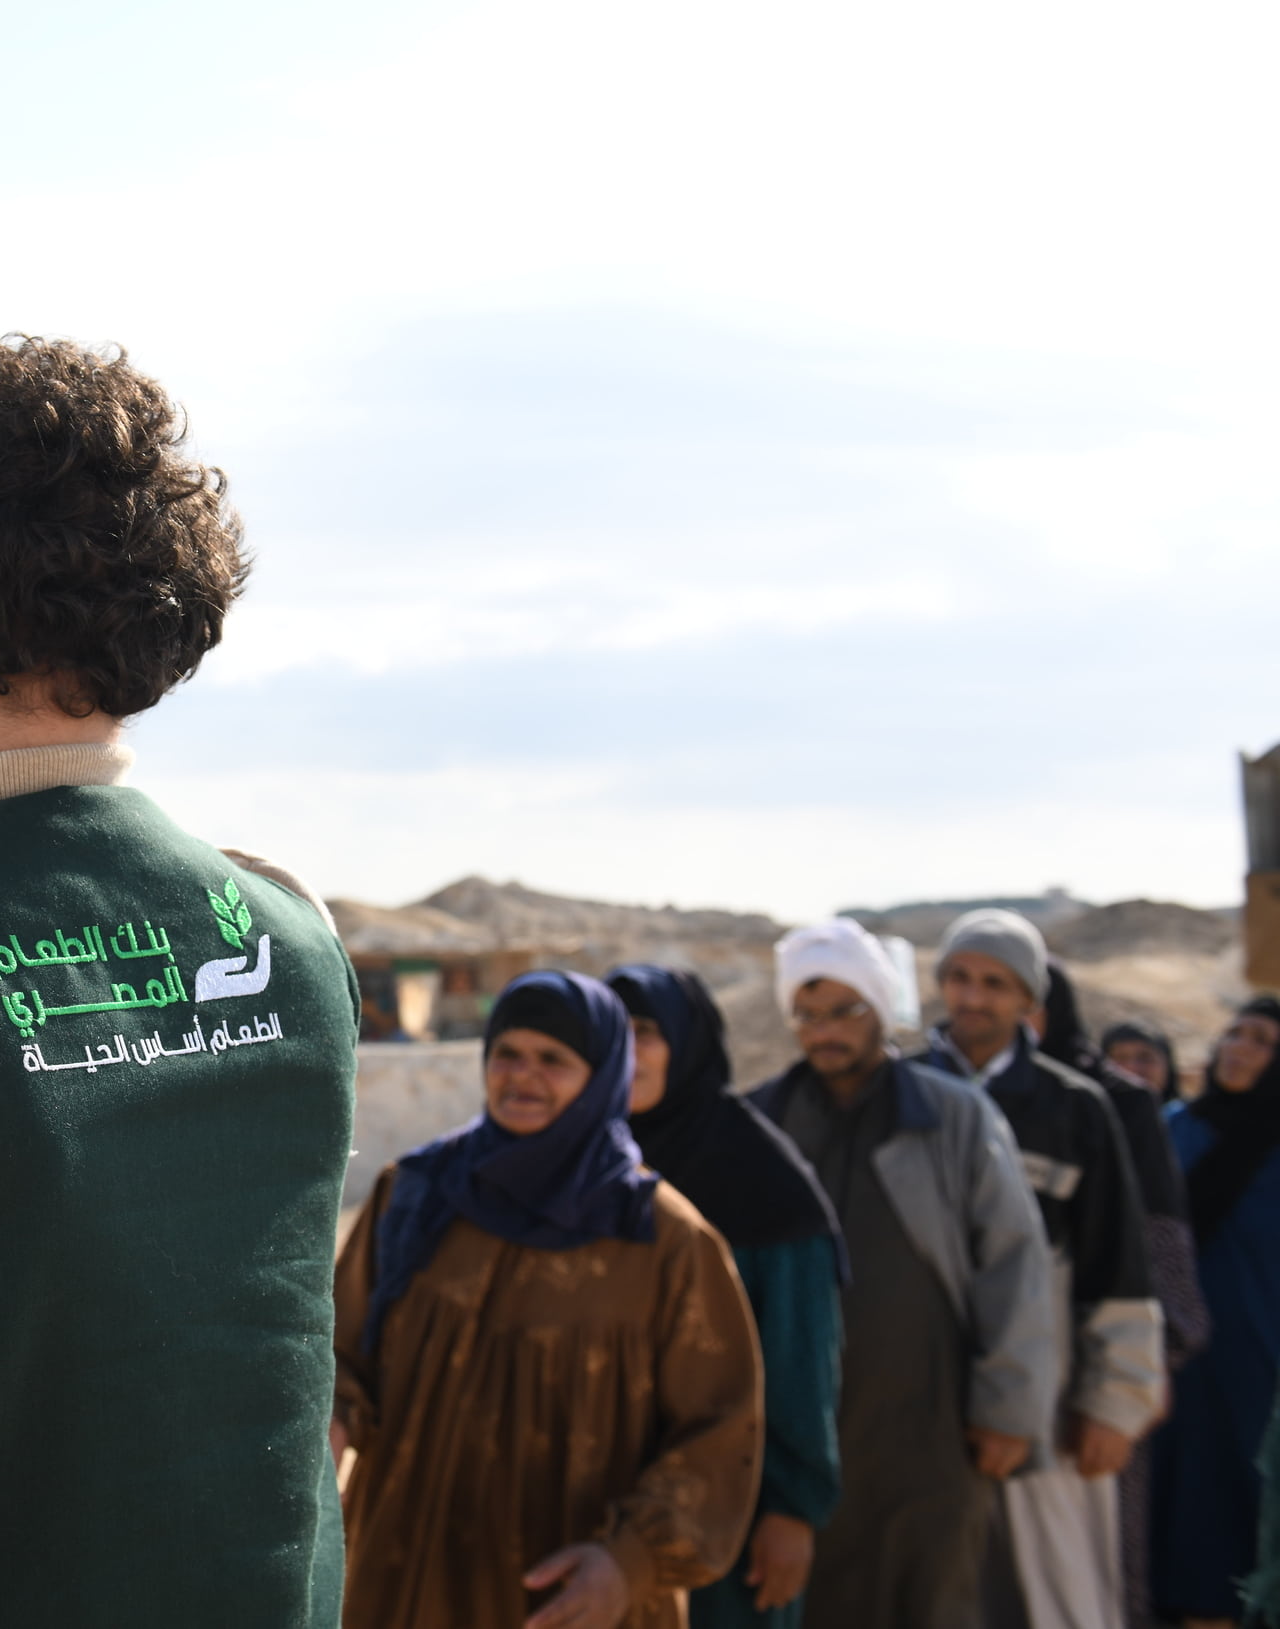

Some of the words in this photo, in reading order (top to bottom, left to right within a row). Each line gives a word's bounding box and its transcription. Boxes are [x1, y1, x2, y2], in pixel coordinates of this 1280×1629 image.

[110, 920, 175, 963] بنك
[2, 965, 189, 1037] المصري
[21, 1034, 131, 1073] الحياة
[131, 1014, 208, 1065] أساس
[209, 1012, 284, 1055] الطعام
